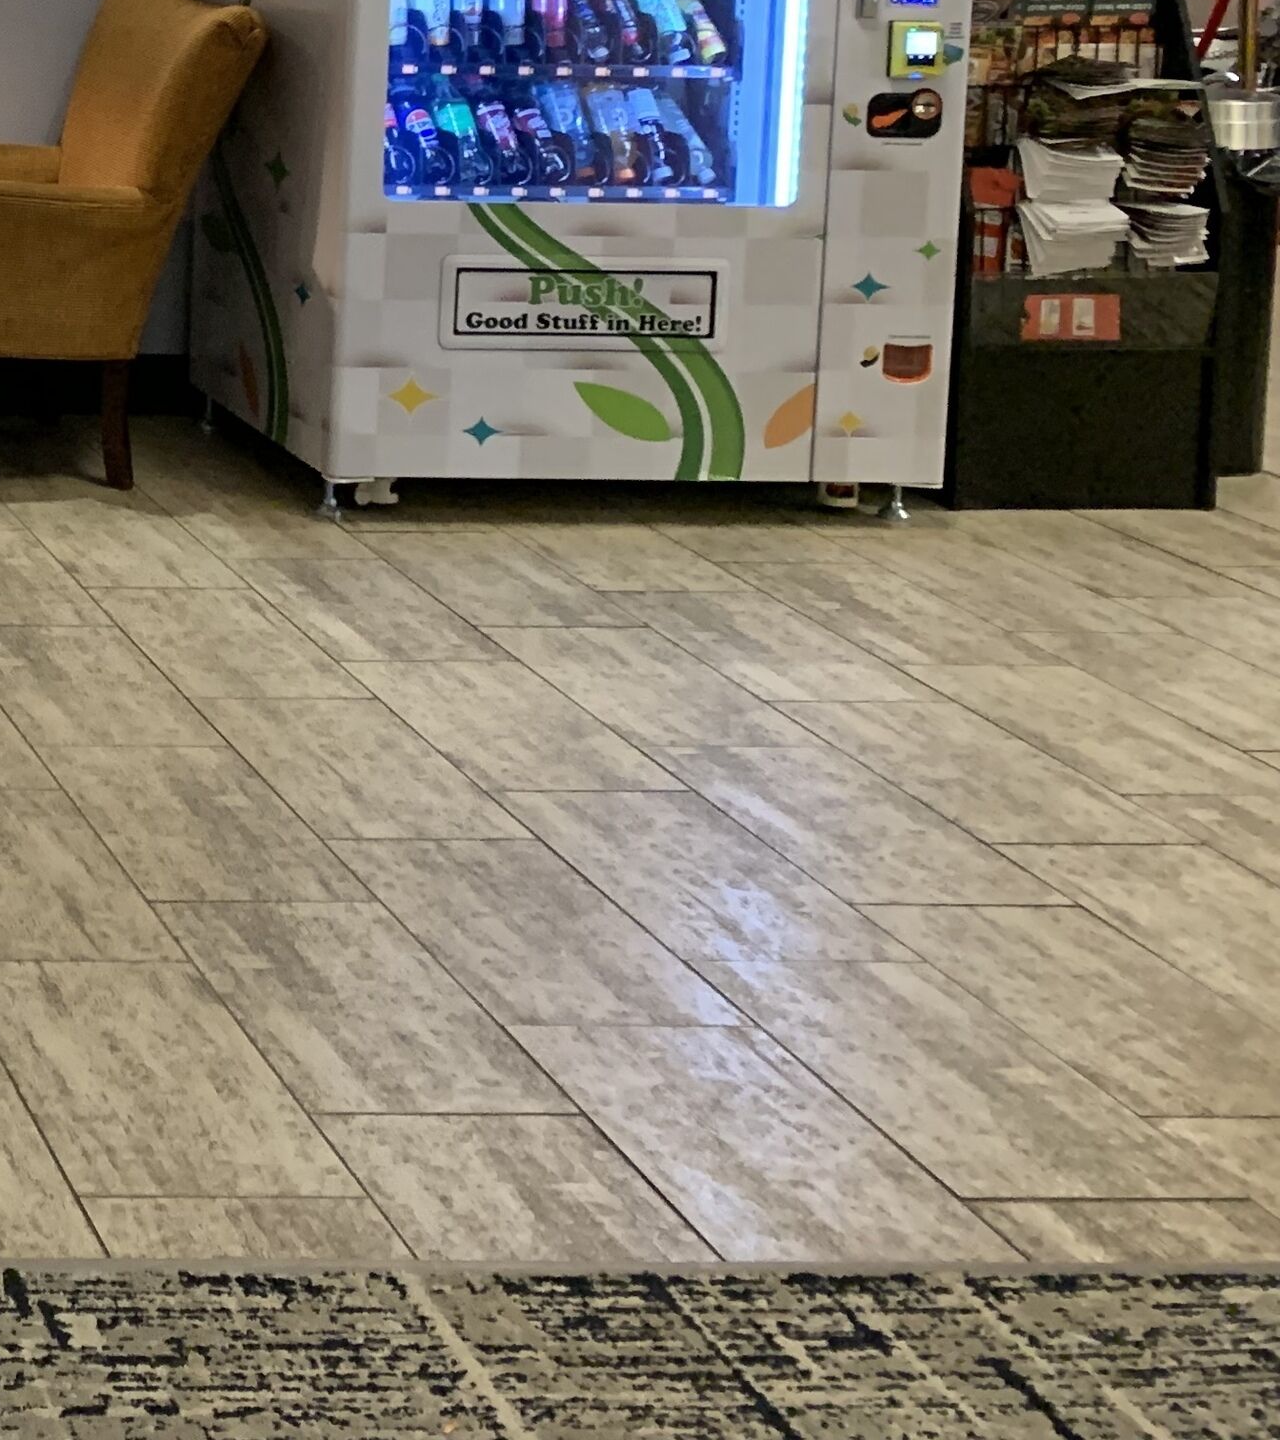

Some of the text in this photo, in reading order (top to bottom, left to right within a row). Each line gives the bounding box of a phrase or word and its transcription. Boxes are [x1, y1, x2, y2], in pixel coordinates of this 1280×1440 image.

[528, 275, 644, 308] Push!
[465, 312, 702, 333] Good Stuff in Here!
